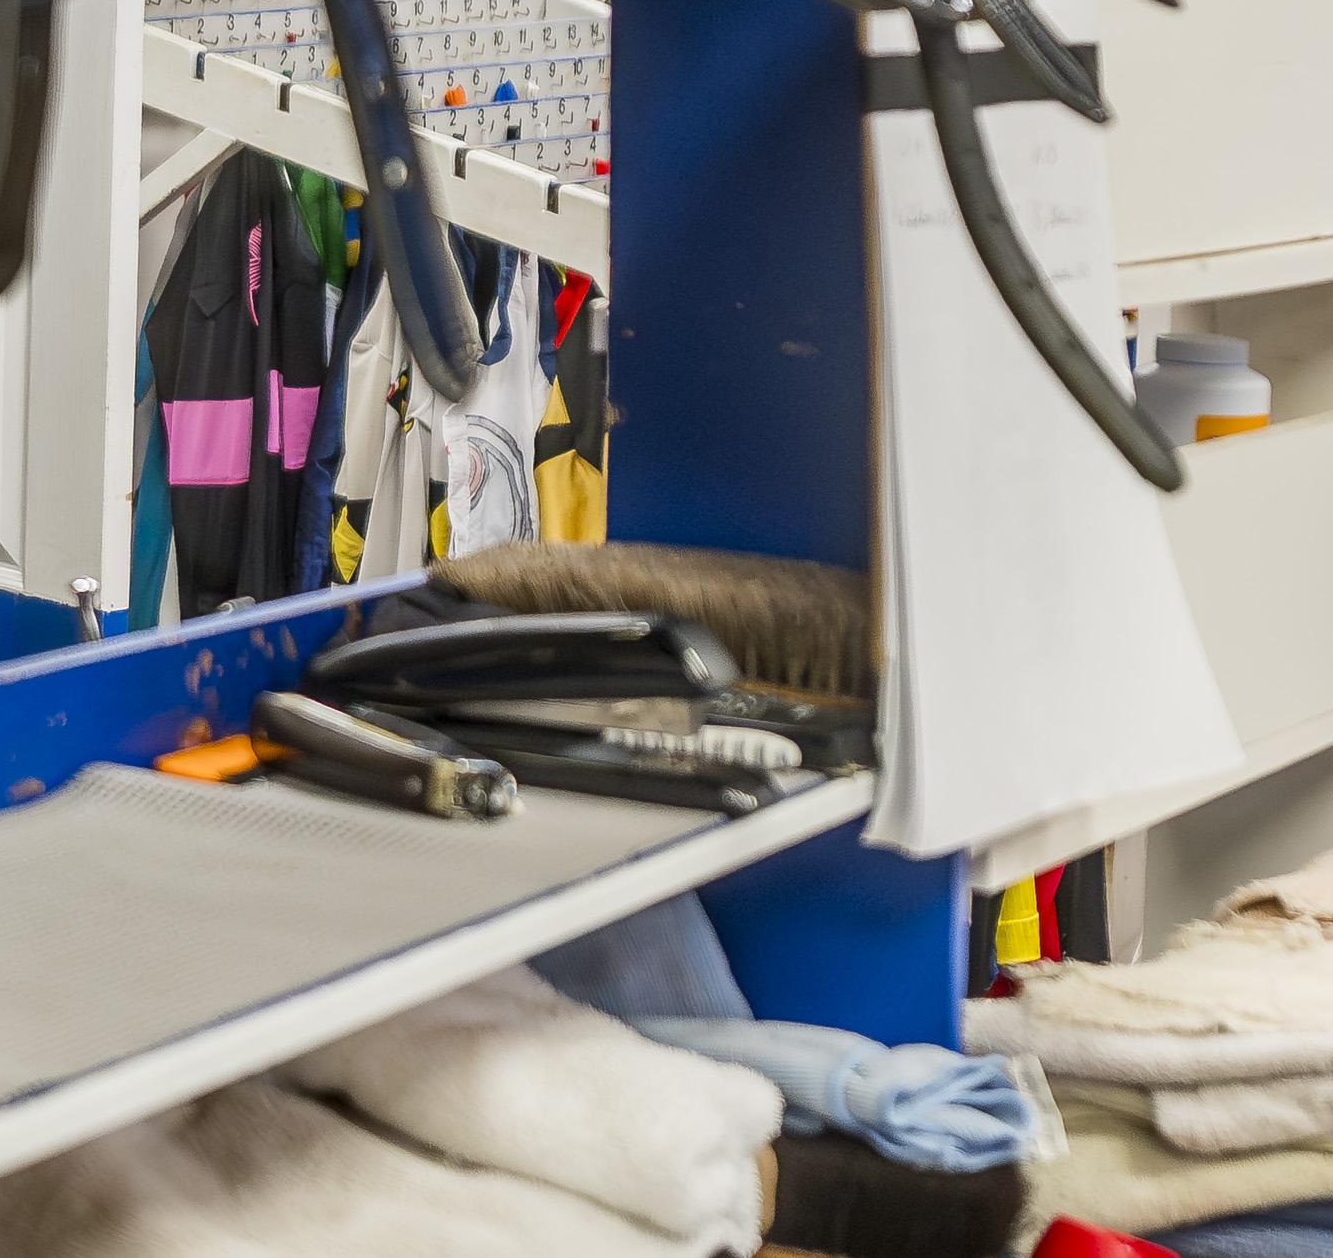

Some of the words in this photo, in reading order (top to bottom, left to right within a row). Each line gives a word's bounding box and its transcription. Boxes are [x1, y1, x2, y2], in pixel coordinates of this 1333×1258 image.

[197, 18, 204, 34] 2
[227, 14, 235, 30] 3
[255, 13, 261, 29] 4
[284, 12, 291, 28] 5
[311, 9, 318, 25] 6
[390, 2, 397, 17] 9
[414, 0, 424, 15] 10
[308, 46, 315, 62] 3
[417, 37, 424, 54] 7
[444, 34, 451, 50] 8
[469, 31, 477, 46] 9
[493, 30, 504, 46] 10
[519, 28, 527, 44] 11
[543, 26, 552, 42] 12
[568, 24, 576, 40] 13
[590, 22, 599, 37] 14
[418, 72, 424, 89] 4
[447, 70, 454, 87] 5
[473, 68, 480, 85] 6
[499, 67, 506, 83] 7
[524, 64, 531, 80] 8
[549, 61, 556, 78] 9
[573, 58, 583, 76] 10
[598, 58, 605, 74] 11
[421, 112, 427, 128] 1
[449, 109, 456, 126] 2
[477, 108, 484, 125] 3
[504, 105, 511, 121] 4
[532, 102, 538, 118] 5
[558, 97, 565, 115] 6
[584, 96, 590, 112] 7
[511, 143, 516, 160] 1
[536, 143, 543, 160] 2
[564, 138, 571, 156] 3
[590, 136, 596, 153] 4
